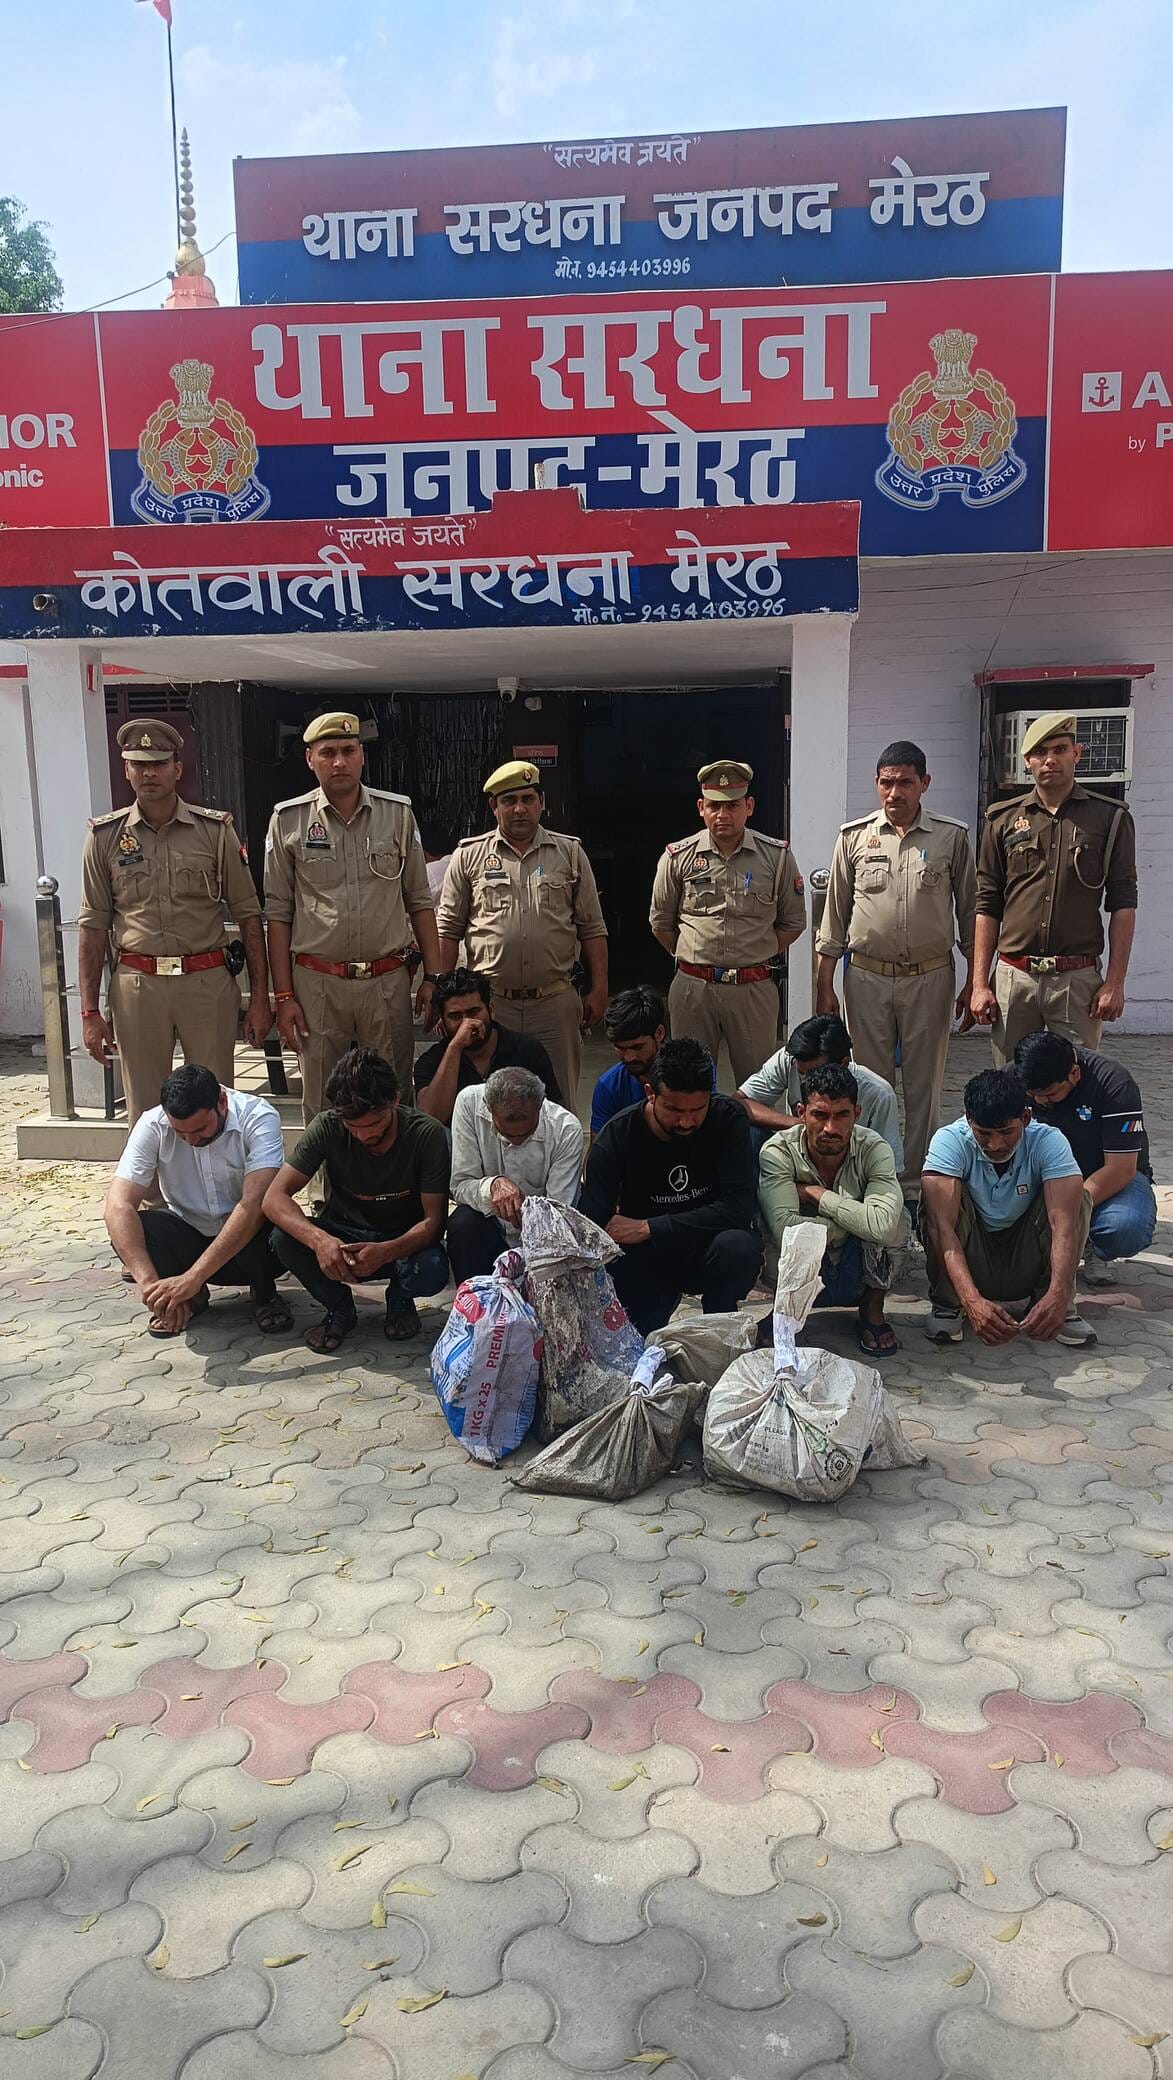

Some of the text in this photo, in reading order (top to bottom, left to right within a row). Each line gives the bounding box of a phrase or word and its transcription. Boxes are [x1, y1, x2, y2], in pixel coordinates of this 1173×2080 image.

[302, 155, 990, 260] थाना सरधना जनपद मेरठ
[586, 257, 691, 279] 9454403996
[251, 301, 887, 420] थाना सरधना
[1128, 435, 1146, 453] by
[0, 463, 44, 488] nic
[890, 465, 1016, 498] उत्तर प्रदेश पुलिस
[144, 492, 260, 521] उत्तर प्रदेश पुलिस
[73, 530, 791, 621] कोतवाली सरधना मेरठ
[641, 598, 787, 623] 9454403996
[650, 1186, 712, 1203] Mercedes-Ben
[470, 1410, 484, 1437] 1KG
[479, 1382, 492, 1398] 25
